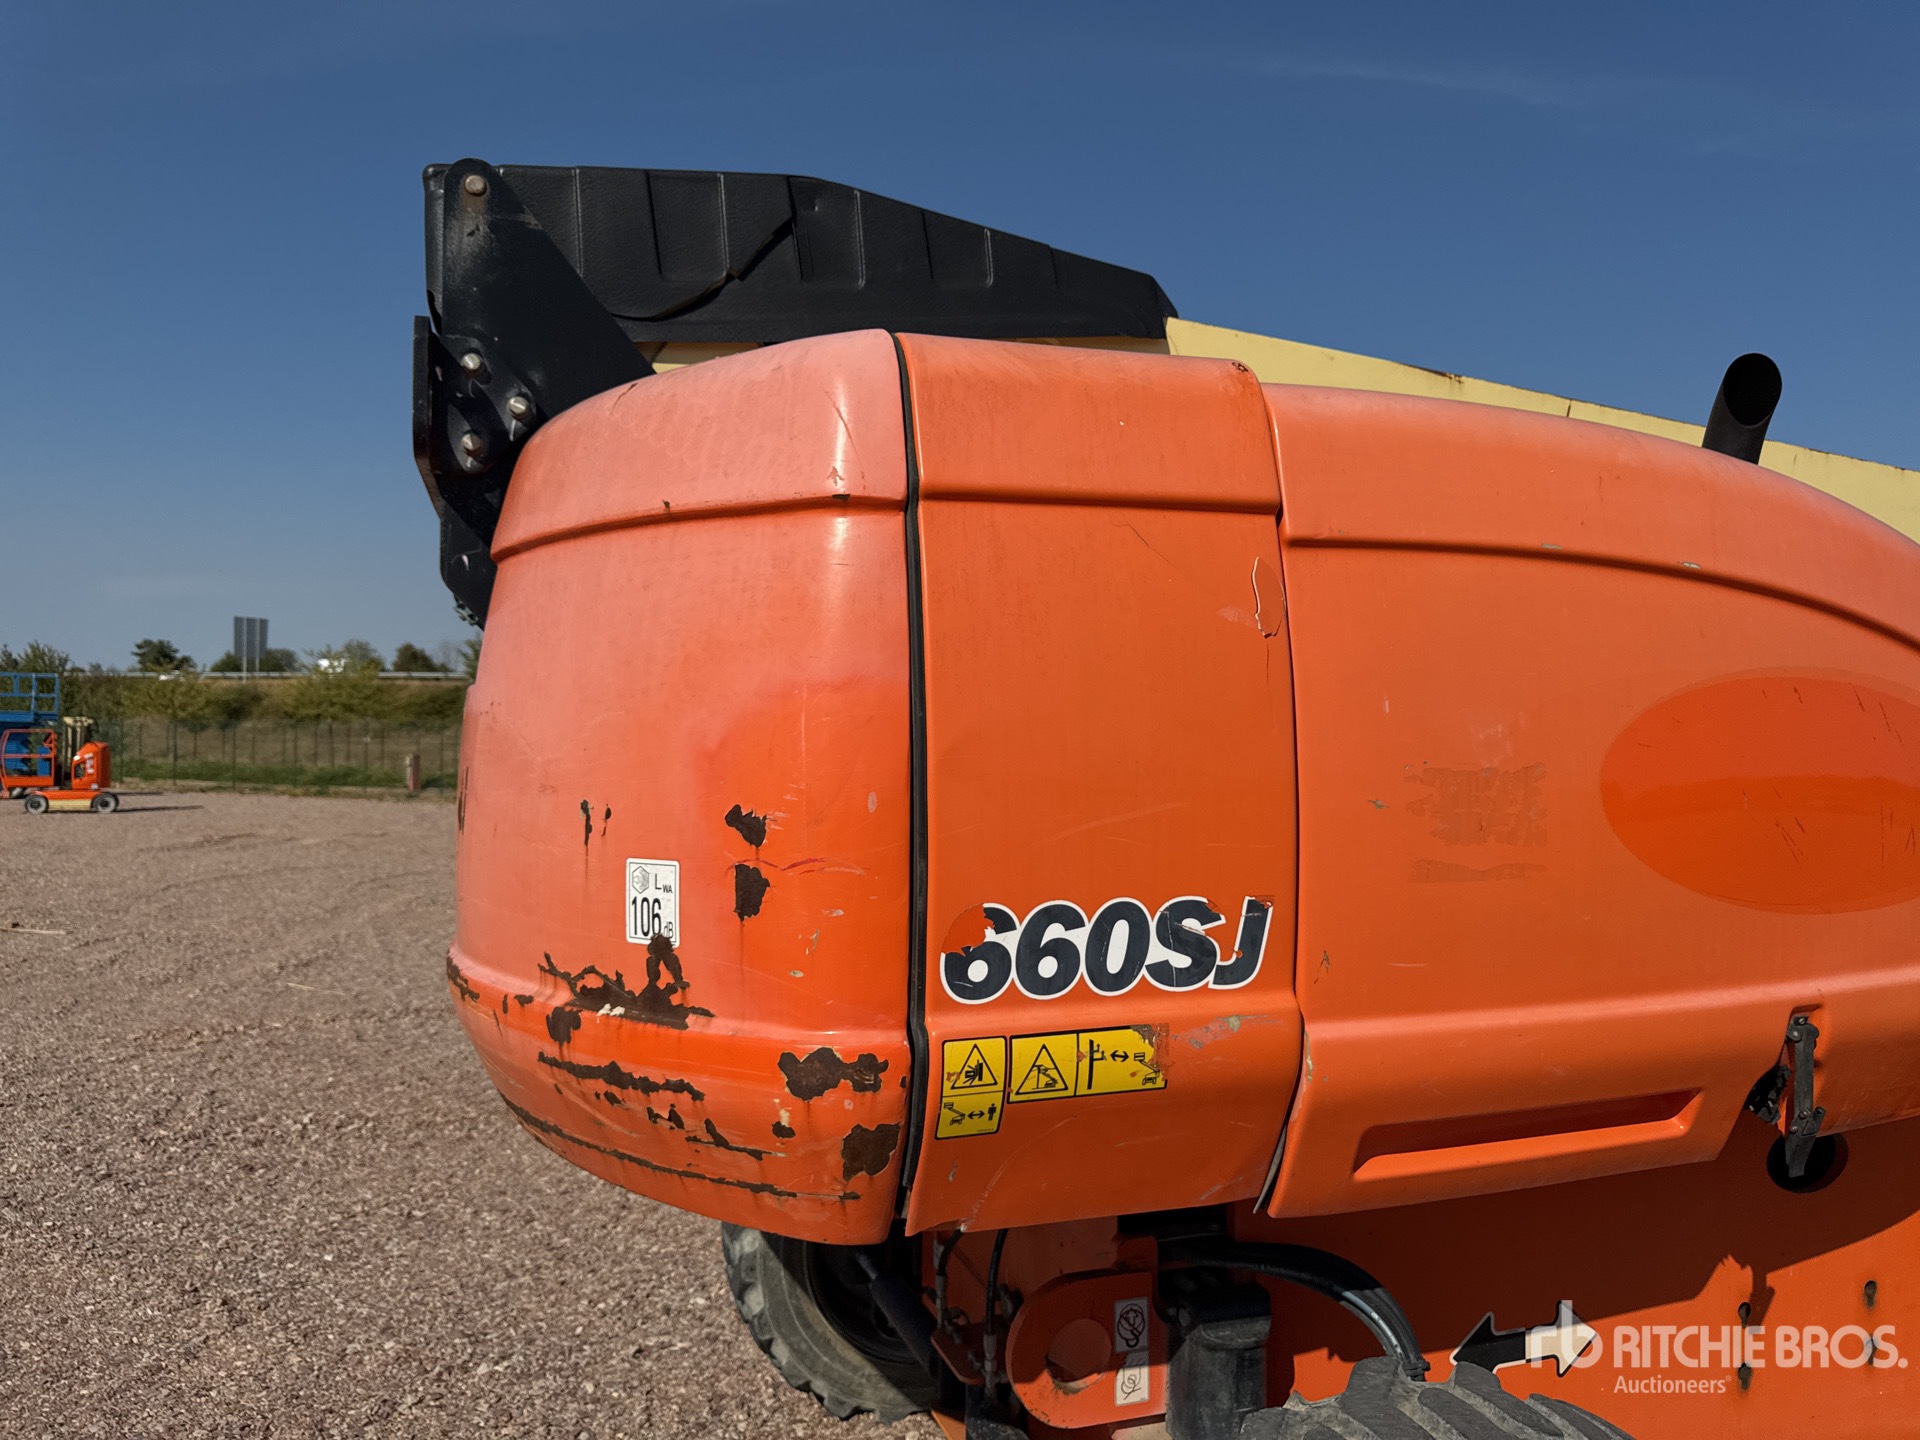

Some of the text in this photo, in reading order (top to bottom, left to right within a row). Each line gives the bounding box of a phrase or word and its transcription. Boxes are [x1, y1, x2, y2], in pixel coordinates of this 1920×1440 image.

[631, 896, 674, 939] 106 dB
[940, 896, 1273, 1004] 660SJ
